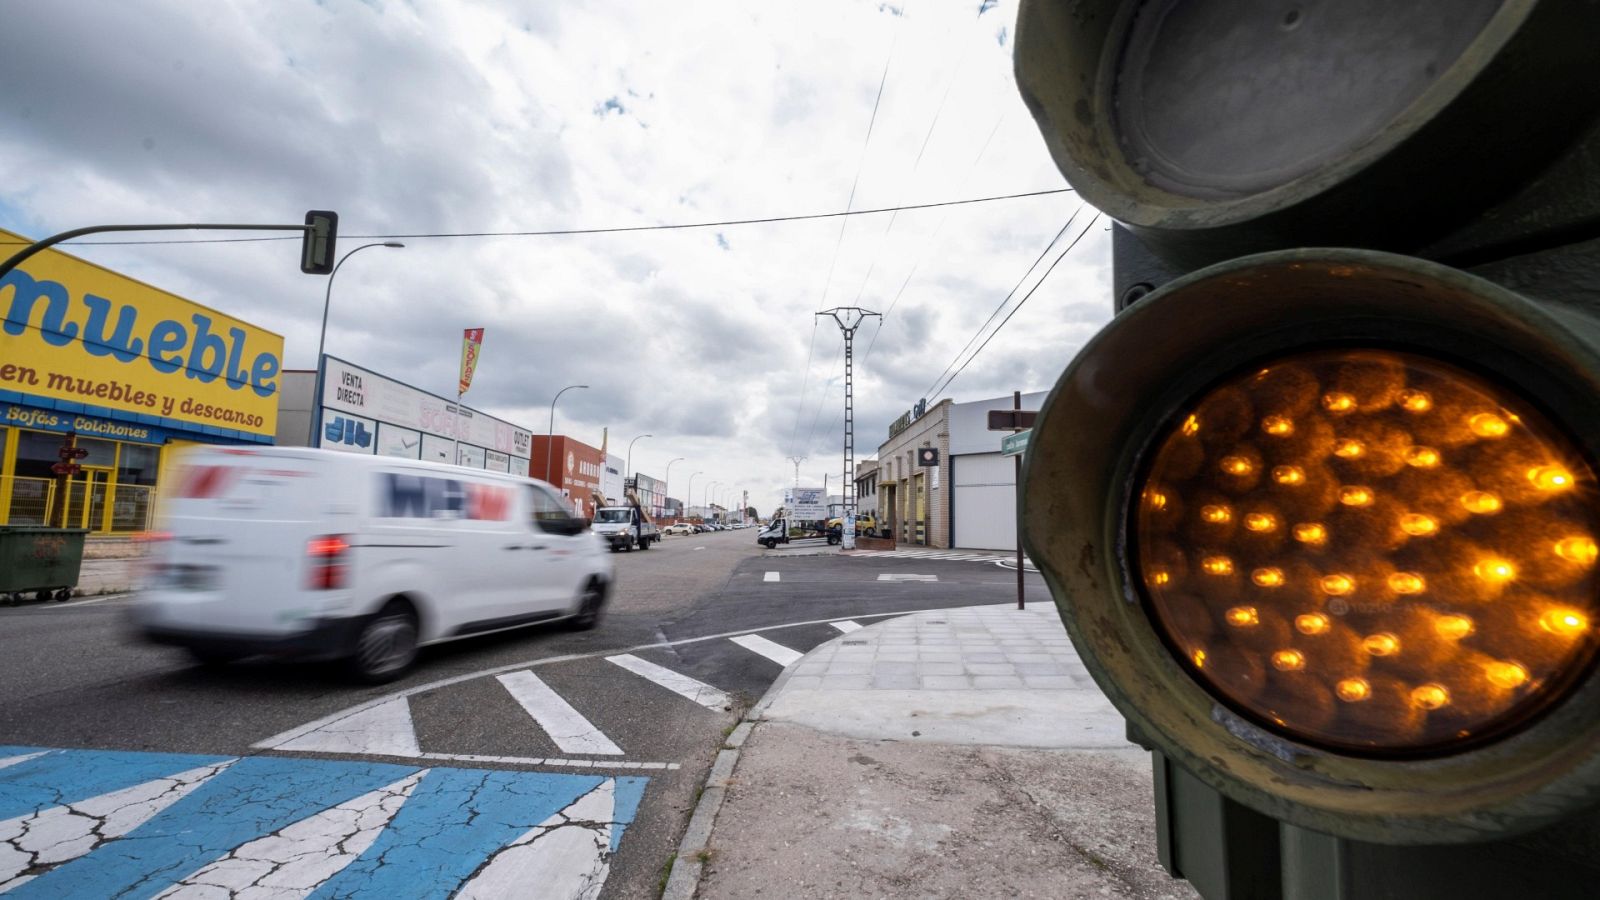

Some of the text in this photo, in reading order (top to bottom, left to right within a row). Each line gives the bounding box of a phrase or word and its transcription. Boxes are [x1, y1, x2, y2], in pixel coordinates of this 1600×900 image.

[342, 370, 362, 390] VENTA
[0, 363, 264, 428] en muebles y descanso
[337, 387, 364, 407] DIRECTA
[73, 417, 148, 438] Colchones
[514, 430, 530, 447] OUTLET
